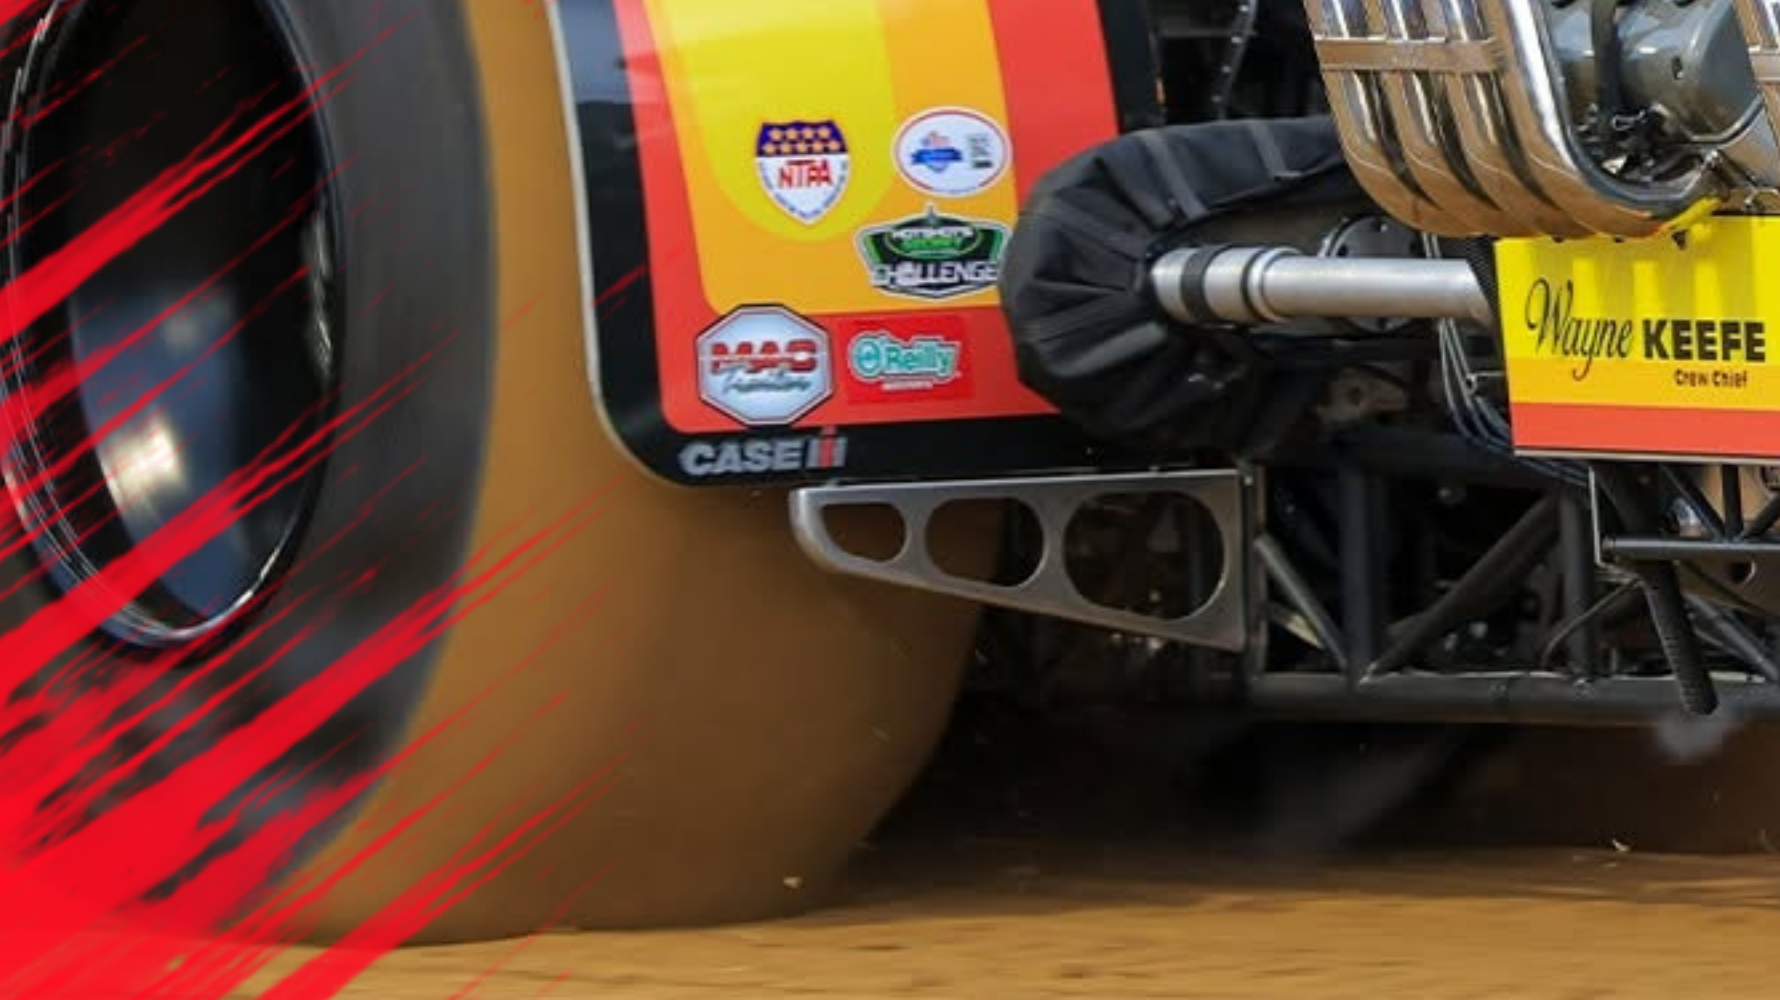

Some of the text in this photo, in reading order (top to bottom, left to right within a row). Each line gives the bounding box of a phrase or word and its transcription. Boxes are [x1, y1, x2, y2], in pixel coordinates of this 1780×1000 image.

[778, 159, 833, 190] NTPA
[1525, 277, 1766, 381] Wayne KEEFE
[1674, 369, 1748, 388] Crew Chief
[678, 439, 801, 475] CASE
